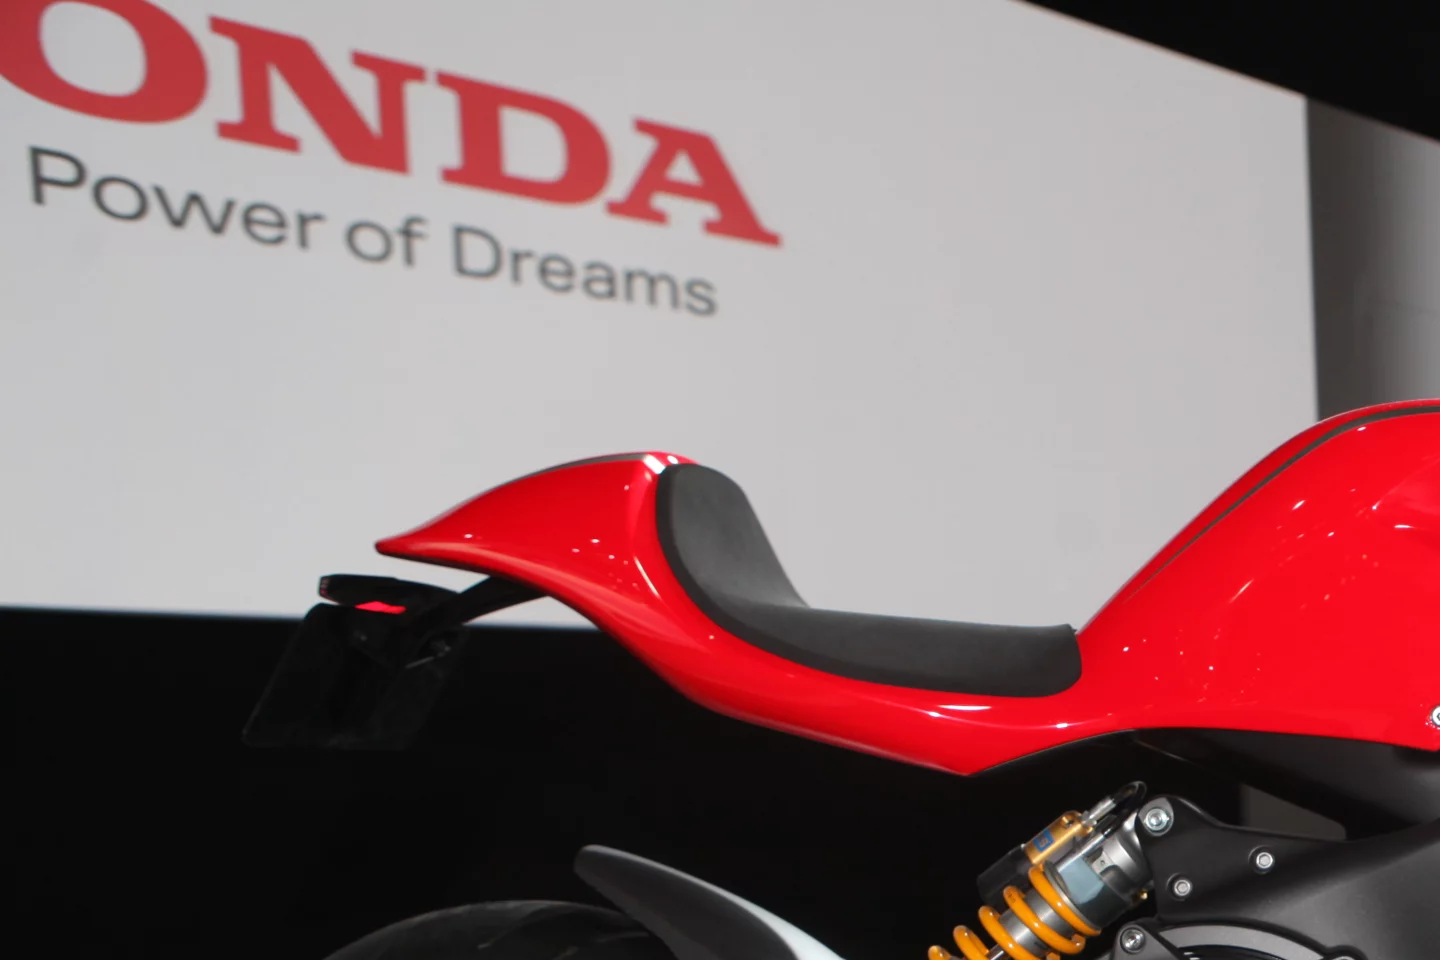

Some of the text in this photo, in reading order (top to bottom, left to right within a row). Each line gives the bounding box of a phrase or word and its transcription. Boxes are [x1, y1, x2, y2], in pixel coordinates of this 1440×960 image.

[28, 145, 718, 316] Power of Dreams
